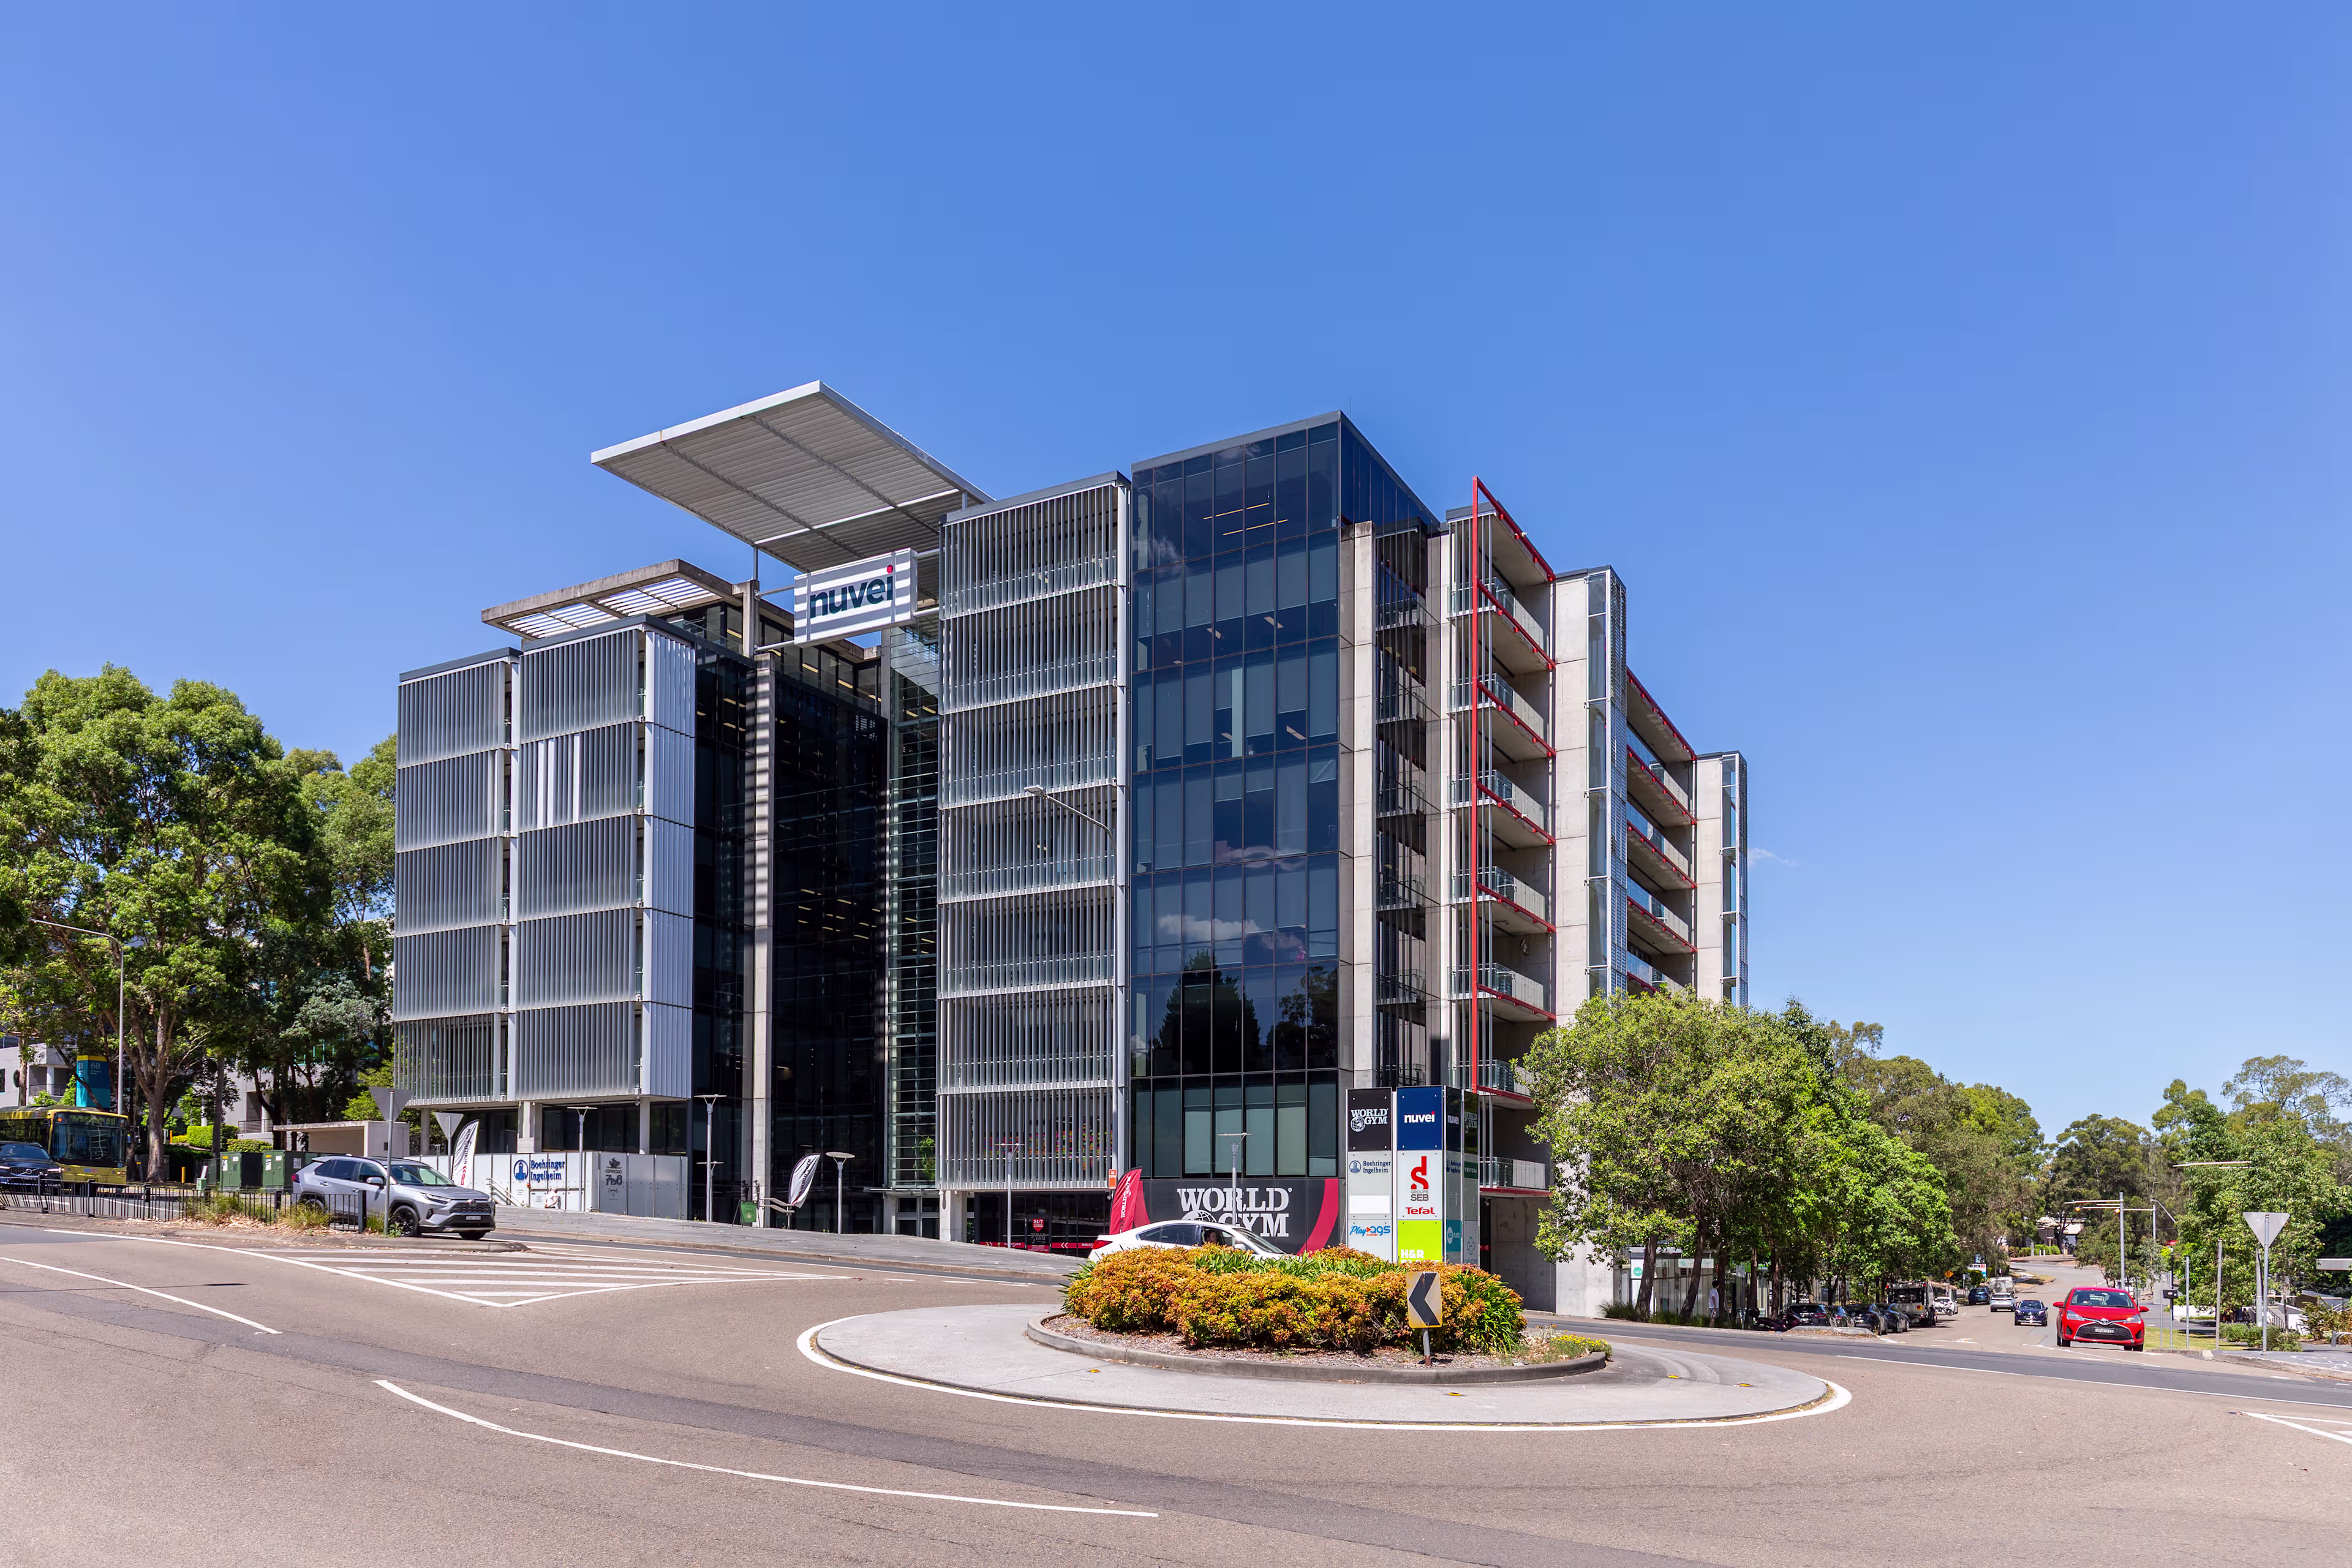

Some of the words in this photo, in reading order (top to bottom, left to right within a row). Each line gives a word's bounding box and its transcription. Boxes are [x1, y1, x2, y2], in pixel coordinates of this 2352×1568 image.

[810, 565, 894, 619] nuvei
[1350, 1109, 1388, 1117] WORLD
[1404, 1111, 1435, 1123] nuvei
[1447, 1114, 1460, 1125] nuvei
[530, 1159, 565, 1170] Boehringer
[530, 1170, 562, 1183] Ingelheim
[1177, 1188, 1289, 1212] WORLD
[1401, 1250, 1424, 1259] H&R
